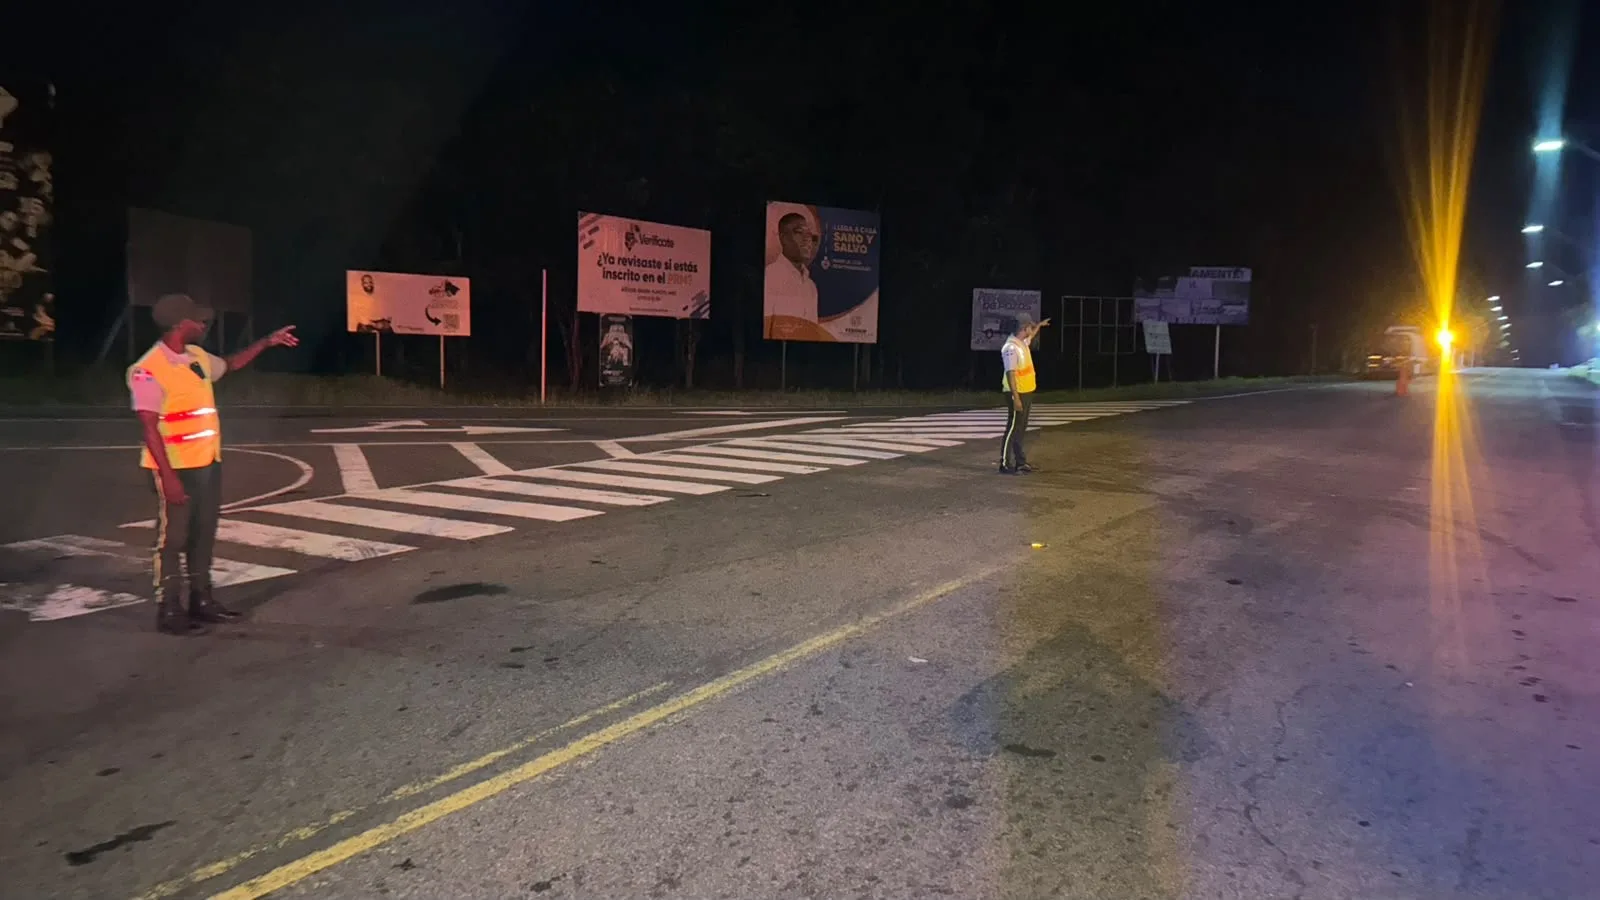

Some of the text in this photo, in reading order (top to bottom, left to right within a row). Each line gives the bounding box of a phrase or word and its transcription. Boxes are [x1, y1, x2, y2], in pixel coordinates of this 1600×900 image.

[833, 231, 874, 244] SANO Y
[833, 242, 868, 254] SALVO
[597, 252, 698, 273] ¿Ya revisaste si estás
[602, 267, 640, 282] inscrito
[642, 273, 655, 283] en
[657, 271, 666, 284] el
